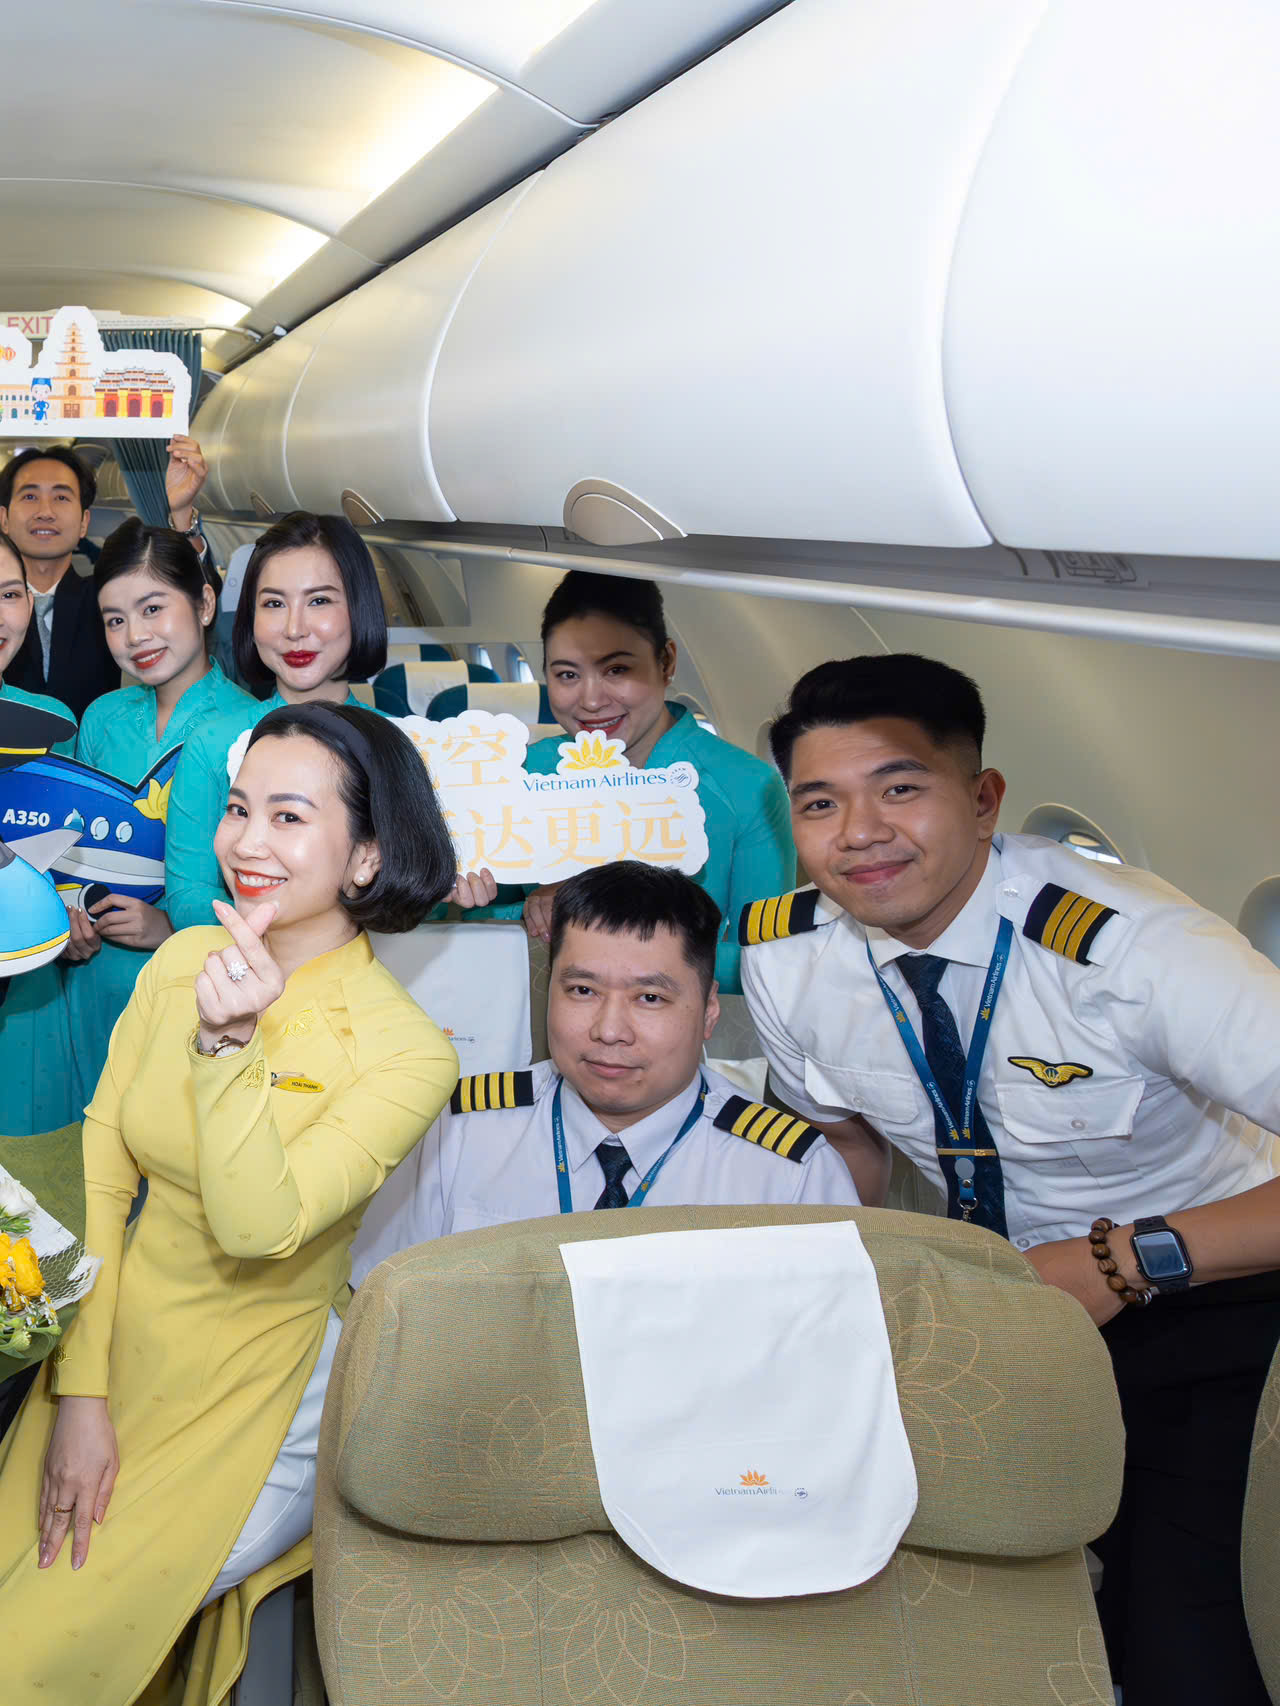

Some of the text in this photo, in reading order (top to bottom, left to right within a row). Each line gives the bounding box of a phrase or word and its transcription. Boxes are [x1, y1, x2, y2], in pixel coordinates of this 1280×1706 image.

[7, 316, 54, 335] EXIT
[523, 777, 596, 792] Vietnam
[600, 771, 667, 788] Airlines
[2, 808, 50, 827] A350
[440, 795, 688, 872] 达更远
